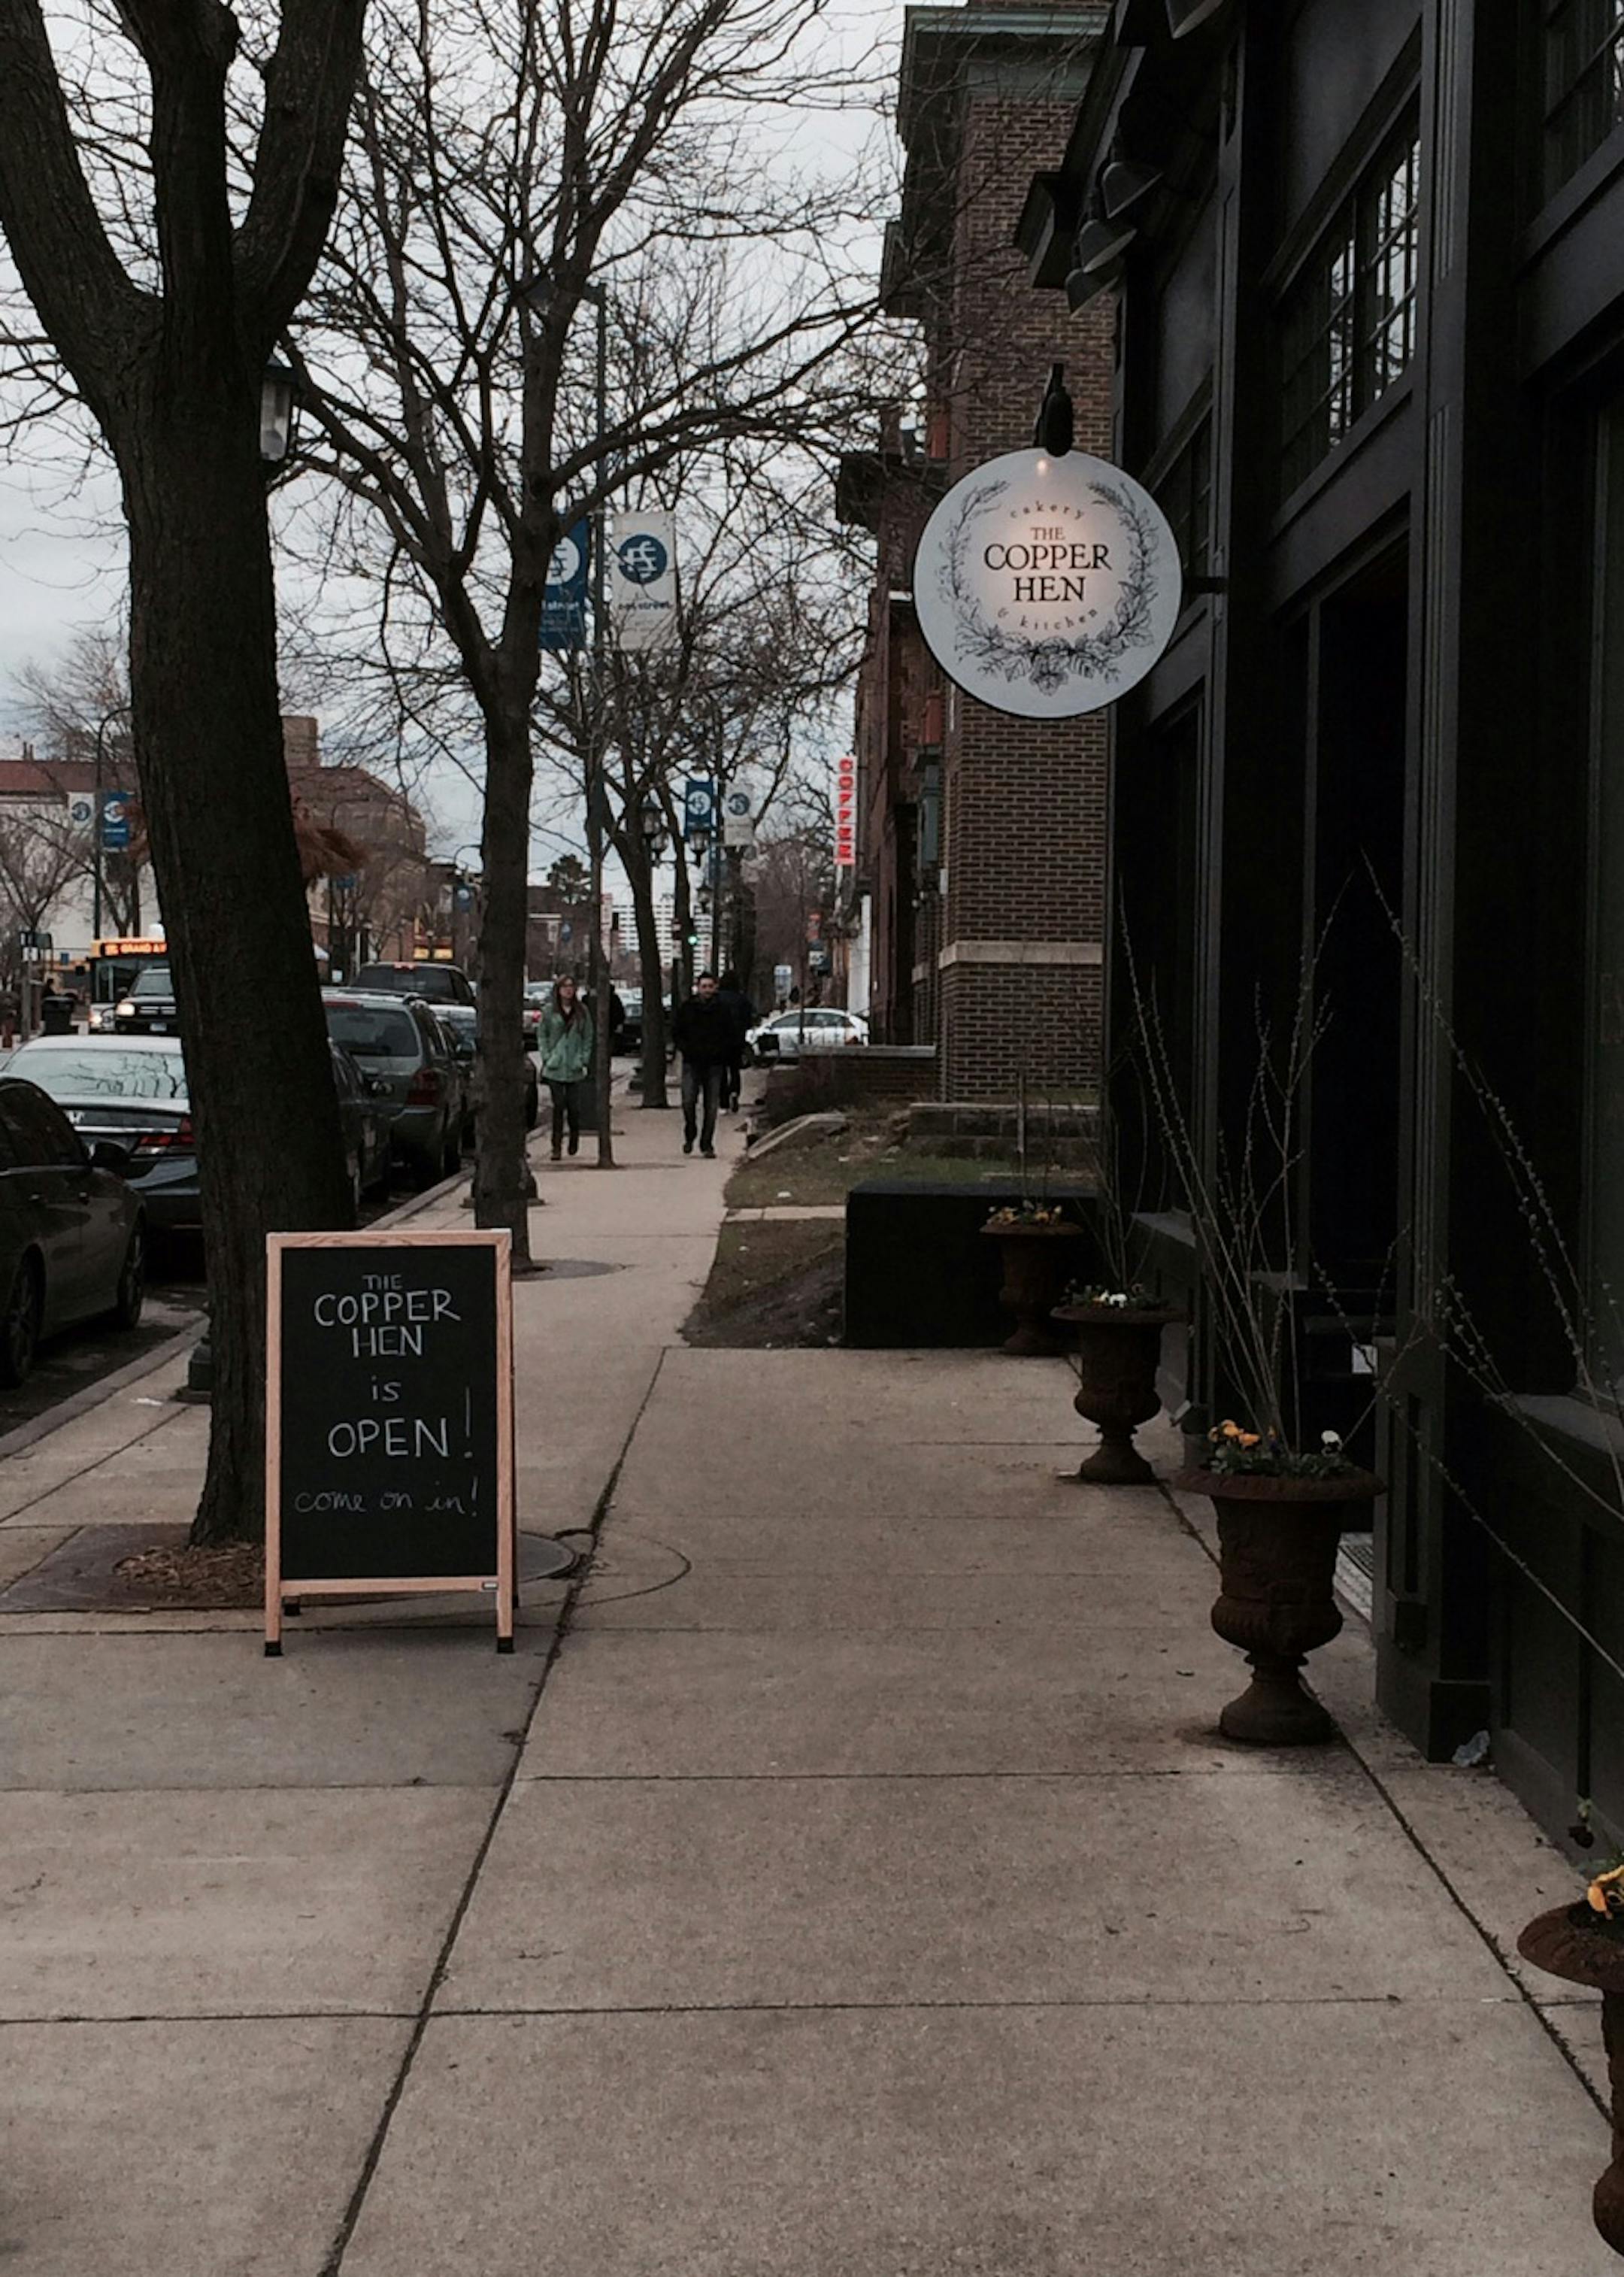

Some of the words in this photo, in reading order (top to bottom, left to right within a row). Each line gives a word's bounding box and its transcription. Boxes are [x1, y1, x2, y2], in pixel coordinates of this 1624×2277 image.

[1010, 500, 1084, 520] cakery
[1030, 527, 1065, 541] THE
[983, 543, 1112, 571] COPPER
[1013, 576, 1086, 602] HEN
[1020, 608, 1098, 631] kitchen
[362, 1274, 403, 1290] THE
[314, 1289, 462, 1326] COPPER
[350, 1324, 423, 1358] HEN
[371, 1375, 401, 1402] is
[294, 1490, 367, 1513] come
[380, 1491, 413, 1511] on
